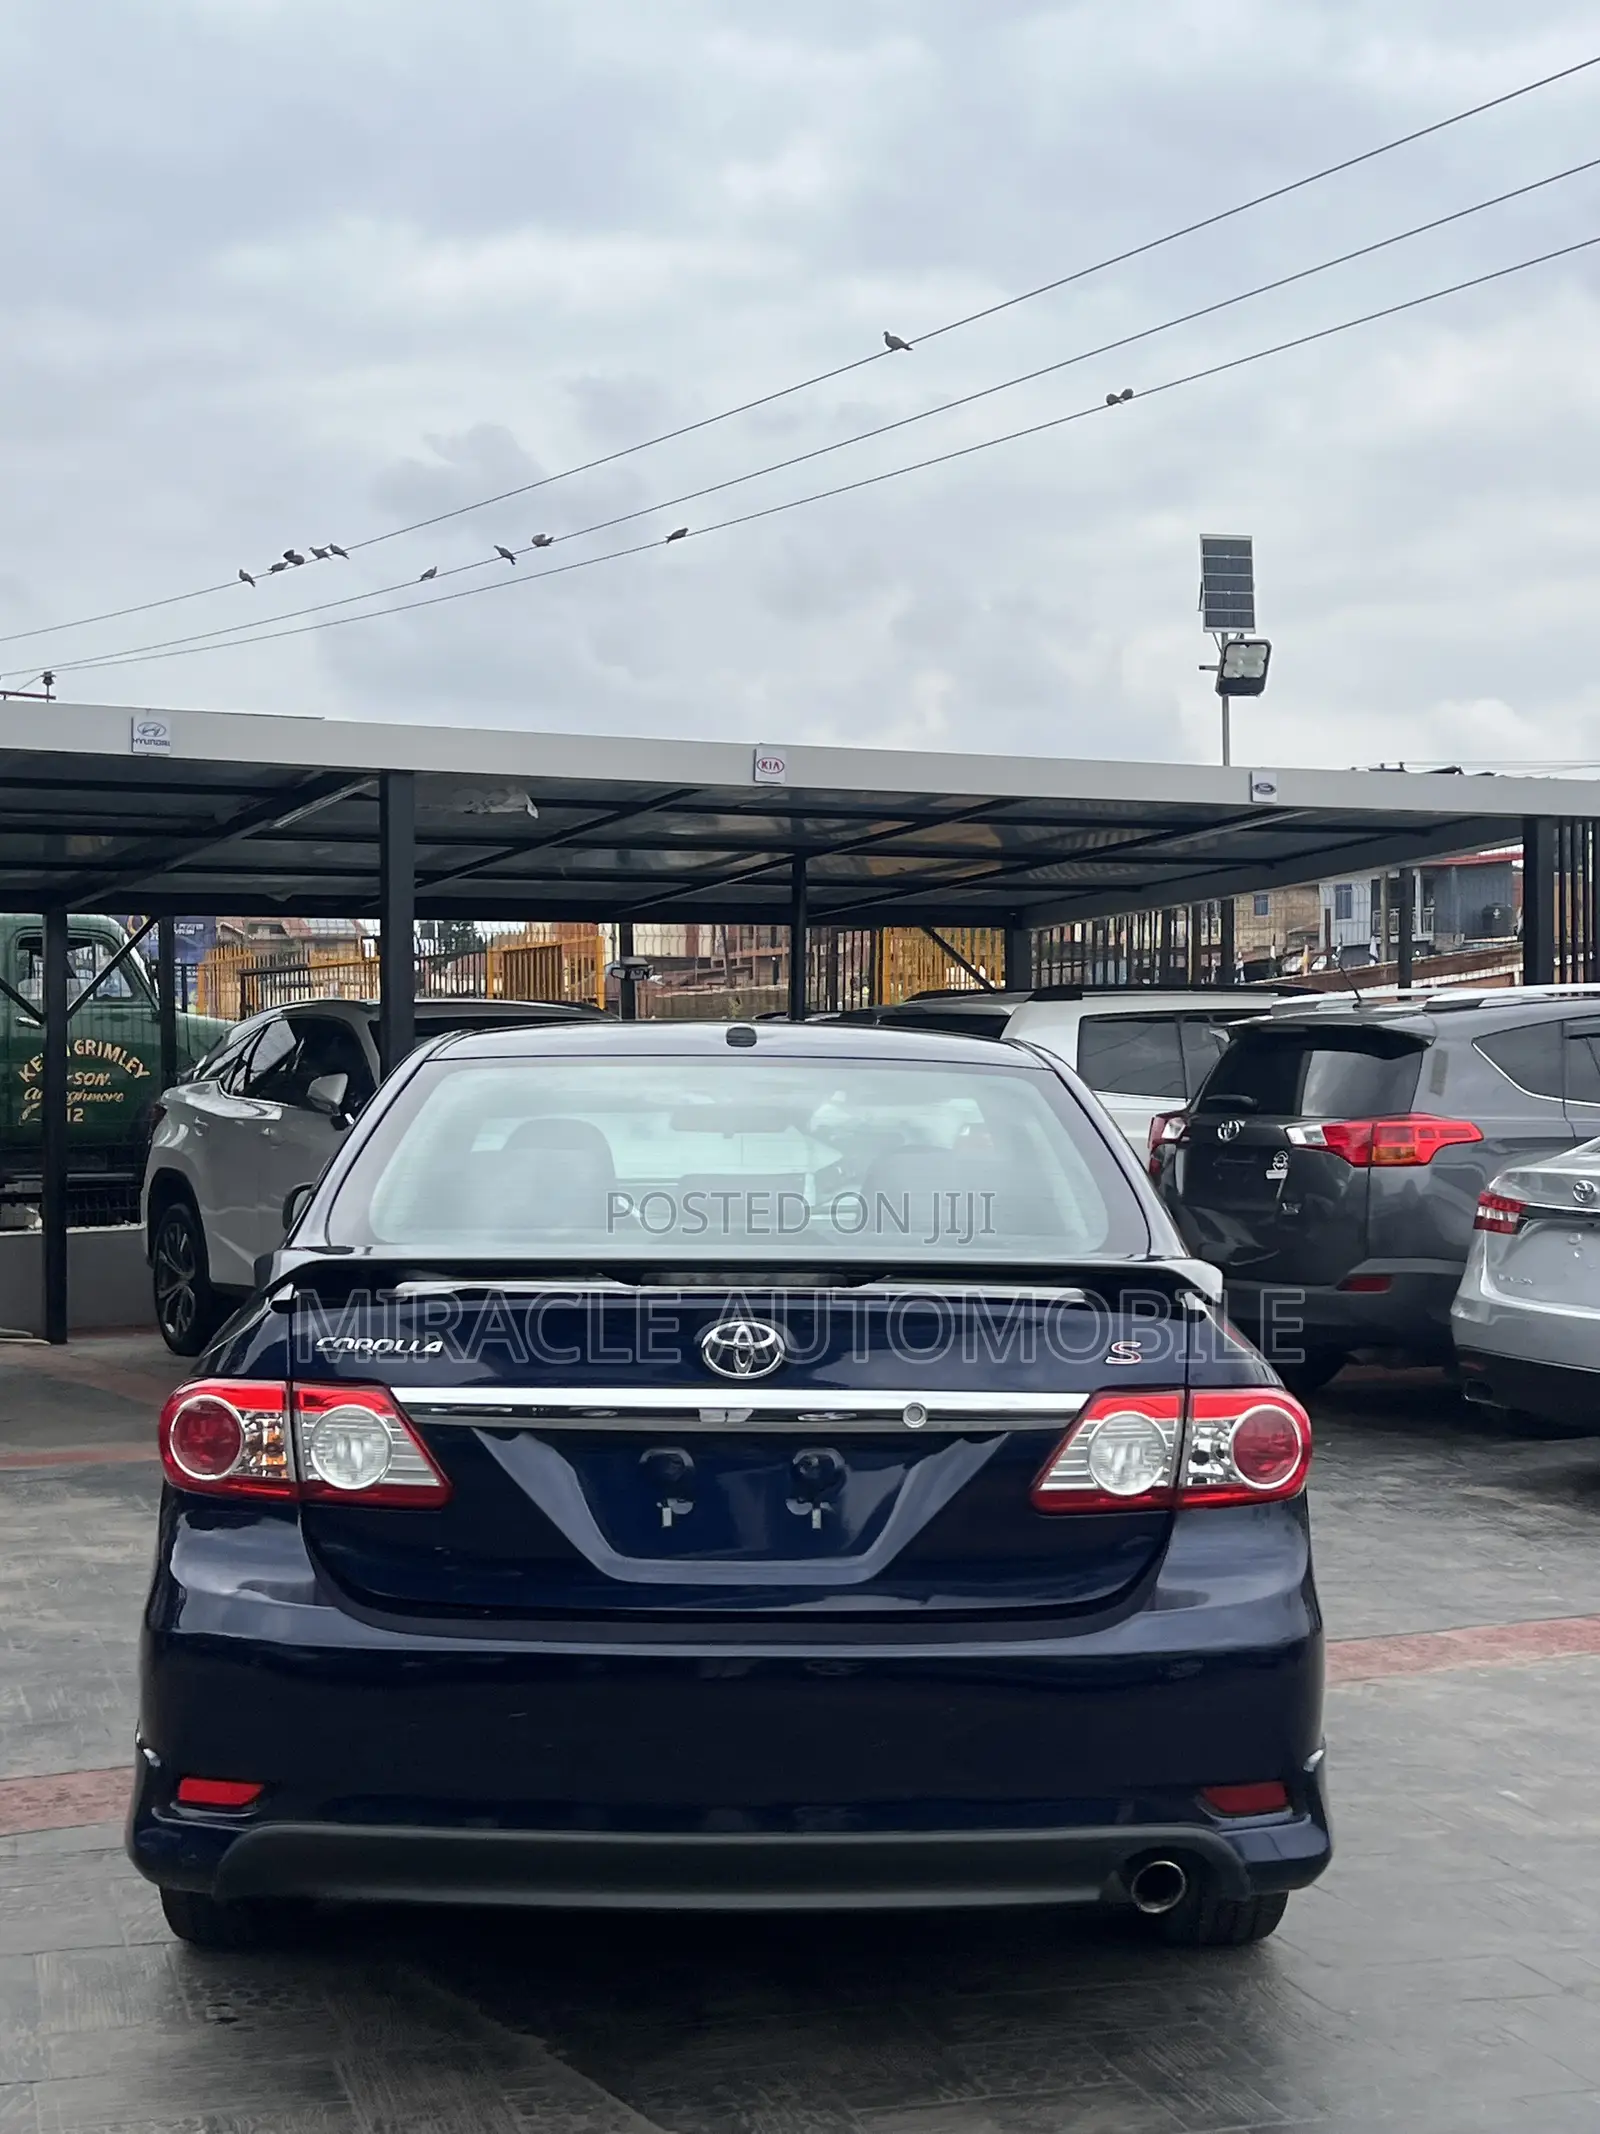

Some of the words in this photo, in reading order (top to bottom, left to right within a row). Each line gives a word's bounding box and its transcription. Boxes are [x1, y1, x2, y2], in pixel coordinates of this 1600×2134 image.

[761, 760, 780, 770] KIA
[73, 1038, 151, 1079] GRIMLEY
[315, 1336, 444, 1355] COROLLA
[1105, 1340, 1142, 1365] S
